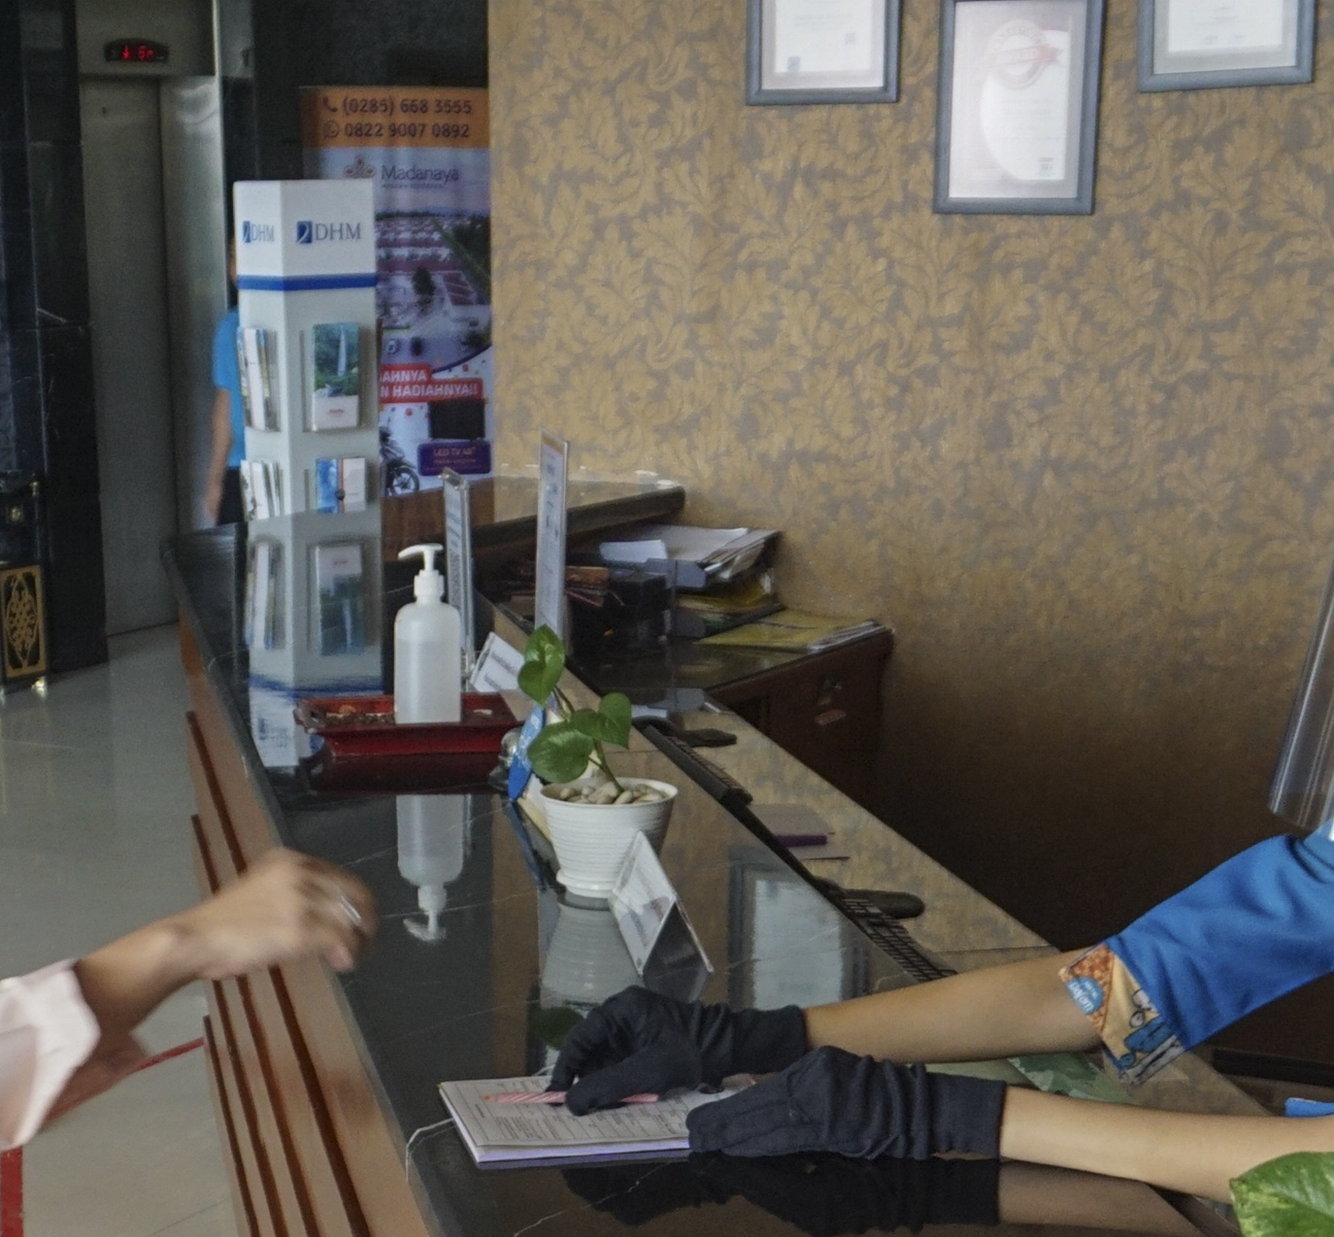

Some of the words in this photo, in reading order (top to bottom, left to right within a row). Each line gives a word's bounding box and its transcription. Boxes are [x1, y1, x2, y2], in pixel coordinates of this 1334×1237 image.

[342, 96, 394, 116] (0285)
[400, 98, 428, 114] 668
[434, 98, 473, 115] 3555
[344, 122, 384, 137] 0822
[388, 122, 427, 137] 9007
[432, 122, 471, 138] 0892
[251, 223, 275, 242] DHM
[315, 222, 362, 241] DHM
[380, 369, 427, 382] AHNYA
[392, 382, 478, 398] HADIAHNYA!!
